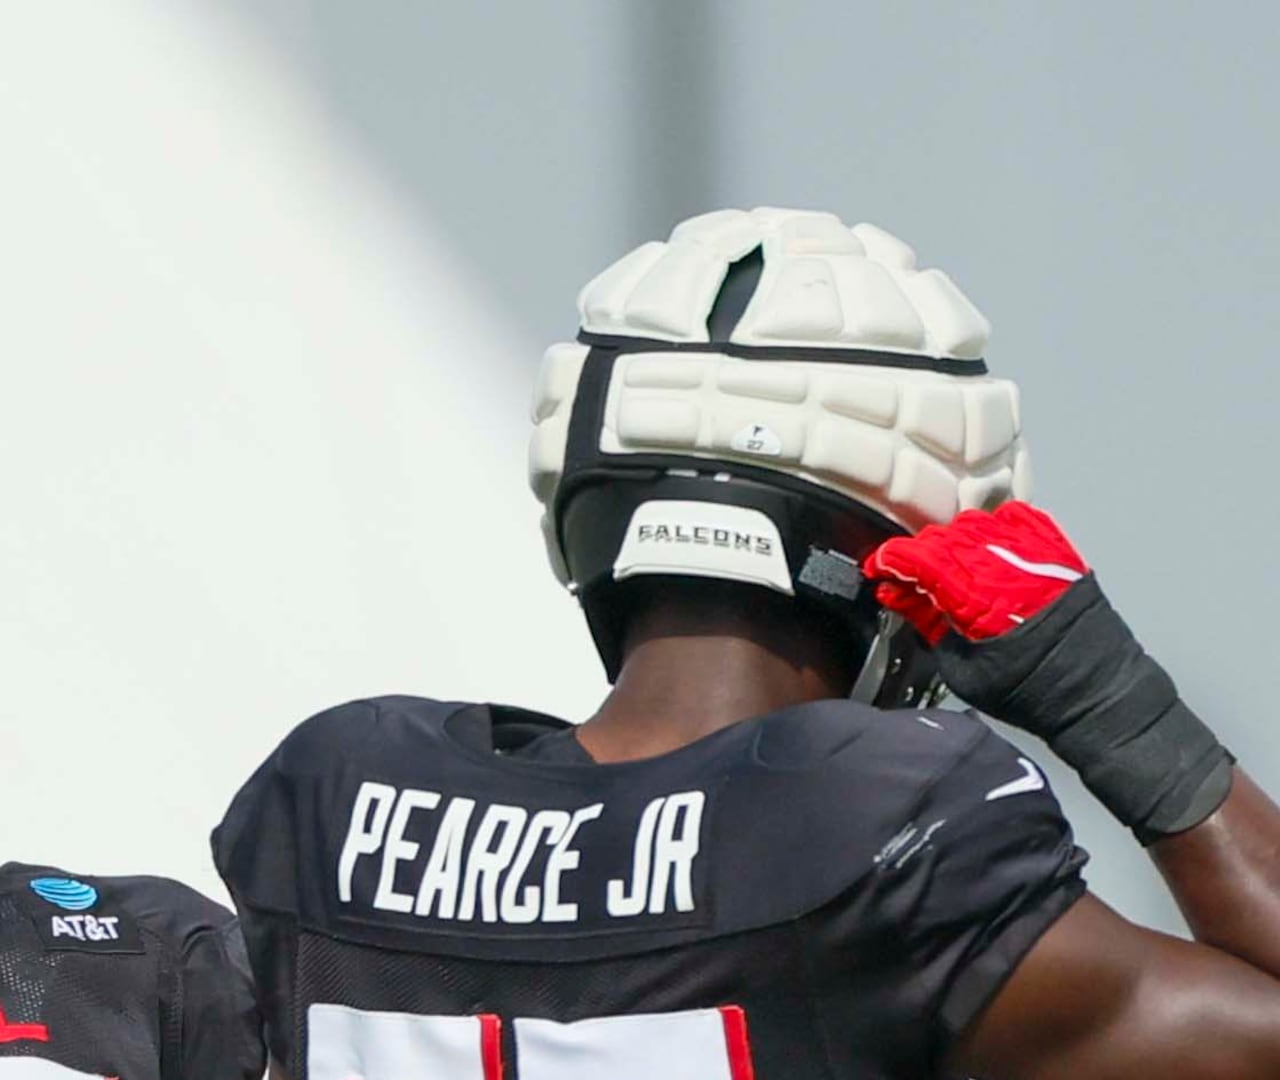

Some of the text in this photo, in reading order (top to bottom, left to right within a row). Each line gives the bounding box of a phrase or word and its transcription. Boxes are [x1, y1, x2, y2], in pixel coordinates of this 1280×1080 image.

[638, 524, 773, 556] FALCONS
[337, 780, 706, 925] PEARCE JR
[51, 914, 119, 941] AT&T
